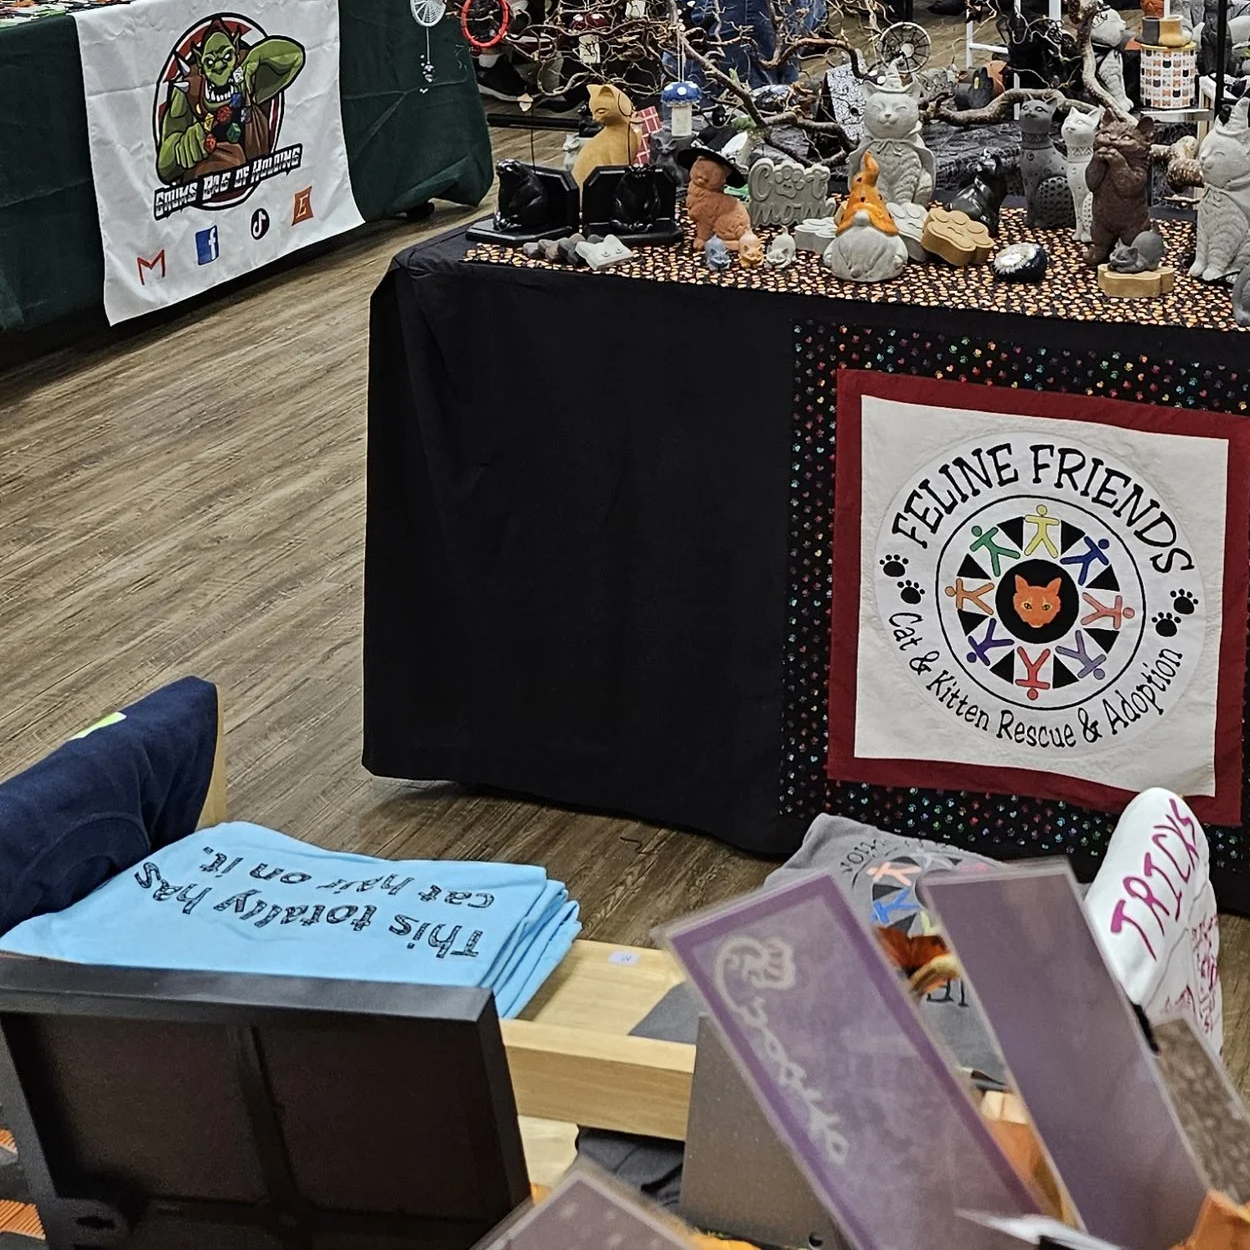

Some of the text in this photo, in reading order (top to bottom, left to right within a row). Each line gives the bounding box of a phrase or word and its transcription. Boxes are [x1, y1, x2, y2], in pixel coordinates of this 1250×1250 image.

[891, 442, 1195, 574] FELINE FRIENDS
[888, 611, 1184, 749] Cat & Kitten Rescue & Adoption
[133, 860, 484, 960] This totally has
[199, 845, 496, 910] cat hair on it.
[1110, 797, 1200, 963] TRICKS
